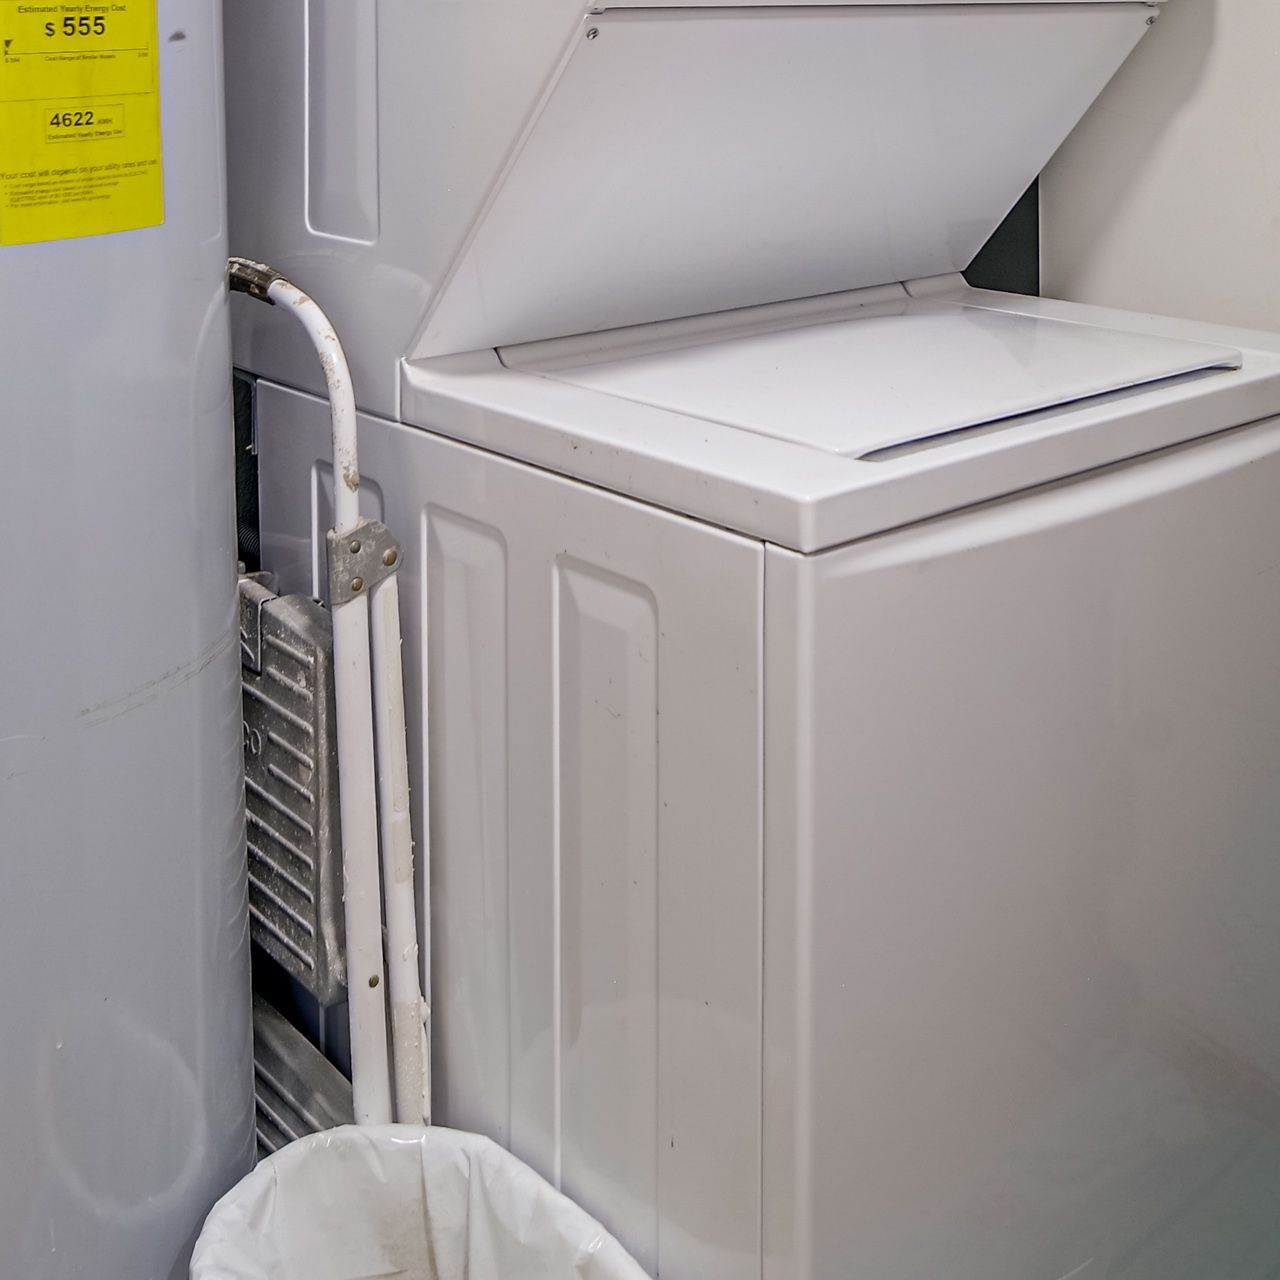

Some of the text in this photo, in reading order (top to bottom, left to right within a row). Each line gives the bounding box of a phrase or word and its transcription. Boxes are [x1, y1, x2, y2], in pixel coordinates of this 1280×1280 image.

[60, 5, 83, 14] Yearly
[85, 5, 109, 14] Energy
[63, 16, 105, 36] 555
[50, 111, 94, 128] 4622
